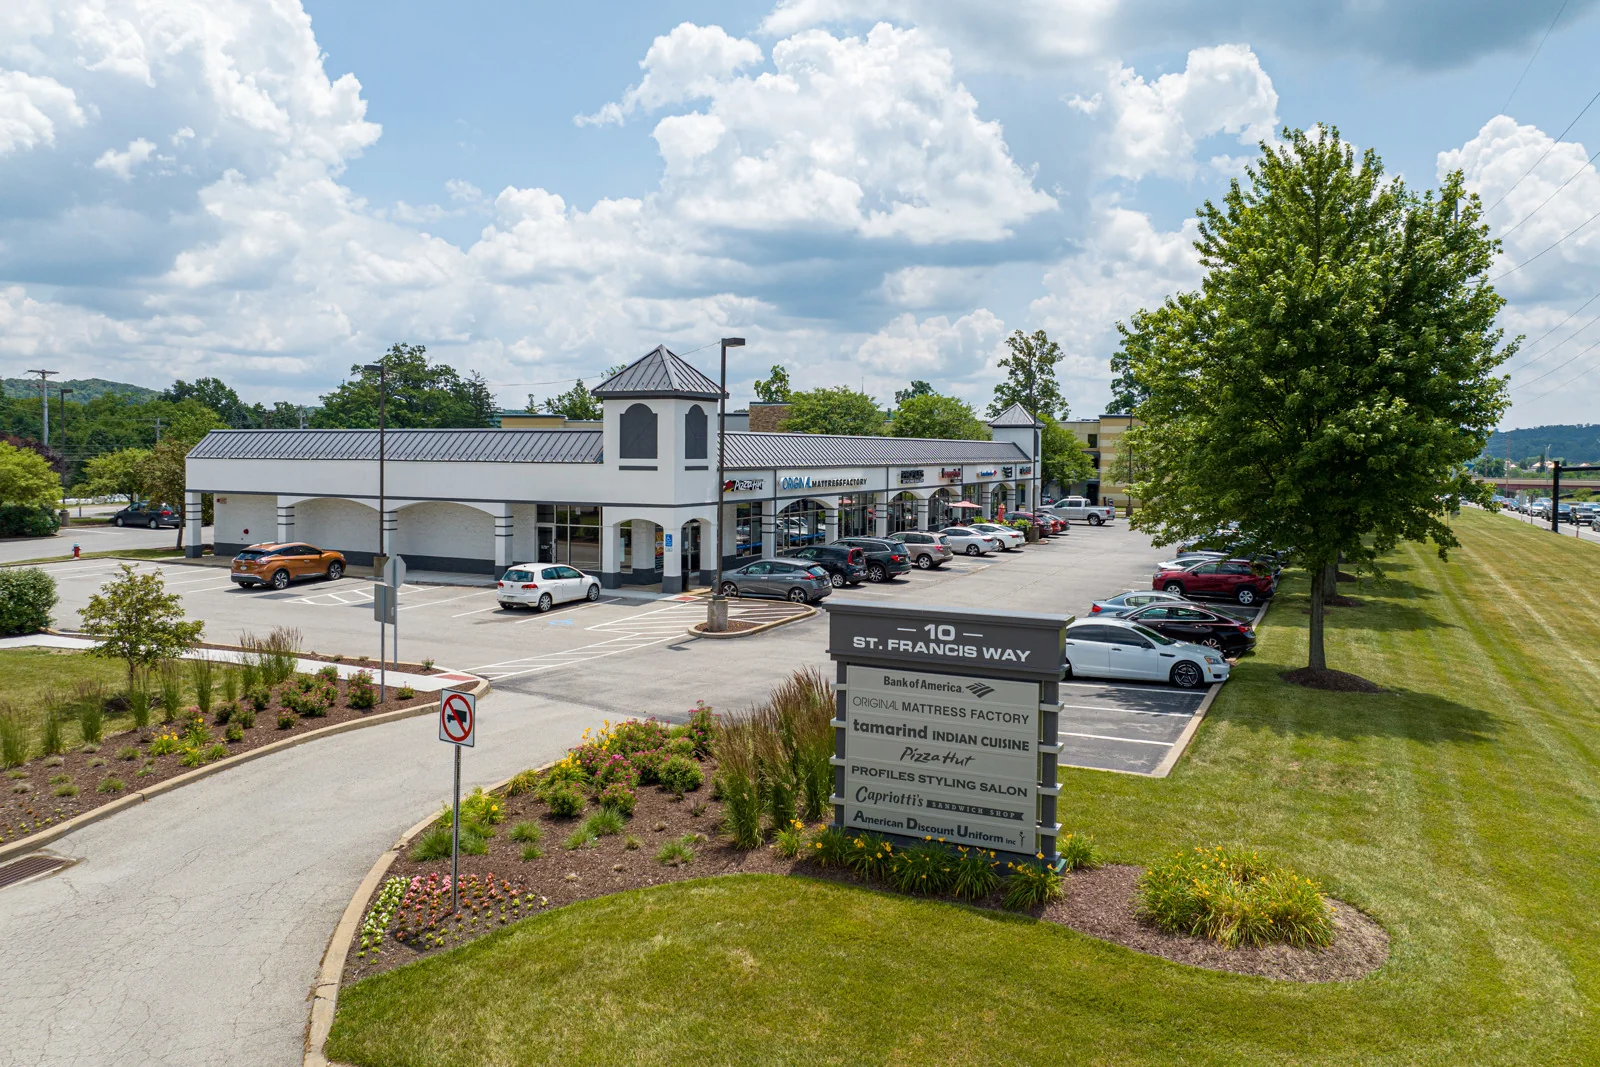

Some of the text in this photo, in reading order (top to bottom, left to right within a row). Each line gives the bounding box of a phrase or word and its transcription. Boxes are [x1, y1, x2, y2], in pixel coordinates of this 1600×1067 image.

[781, 476, 812, 490] ORIGINAL
[924, 624, 956, 641] 10
[853, 636, 1031, 663] ST. FRANCIS WAY
[883, 675, 962, 693] Bank of America
[852, 696, 1030, 725] ORIGINAL MATTRESS FACTORY
[853, 718, 1030, 752] tamarind INDIAN CUISINE
[900, 746, 976, 767] Pizza Hut
[851, 765, 1028, 798] PROFILES STYLING SALON
[855, 785, 1016, 819] Capriotti's SANDWICH SHOP
[853, 810, 904, 829] American
[906, 817, 955, 837] Discount
[956, 824, 1004, 844] Uniform
